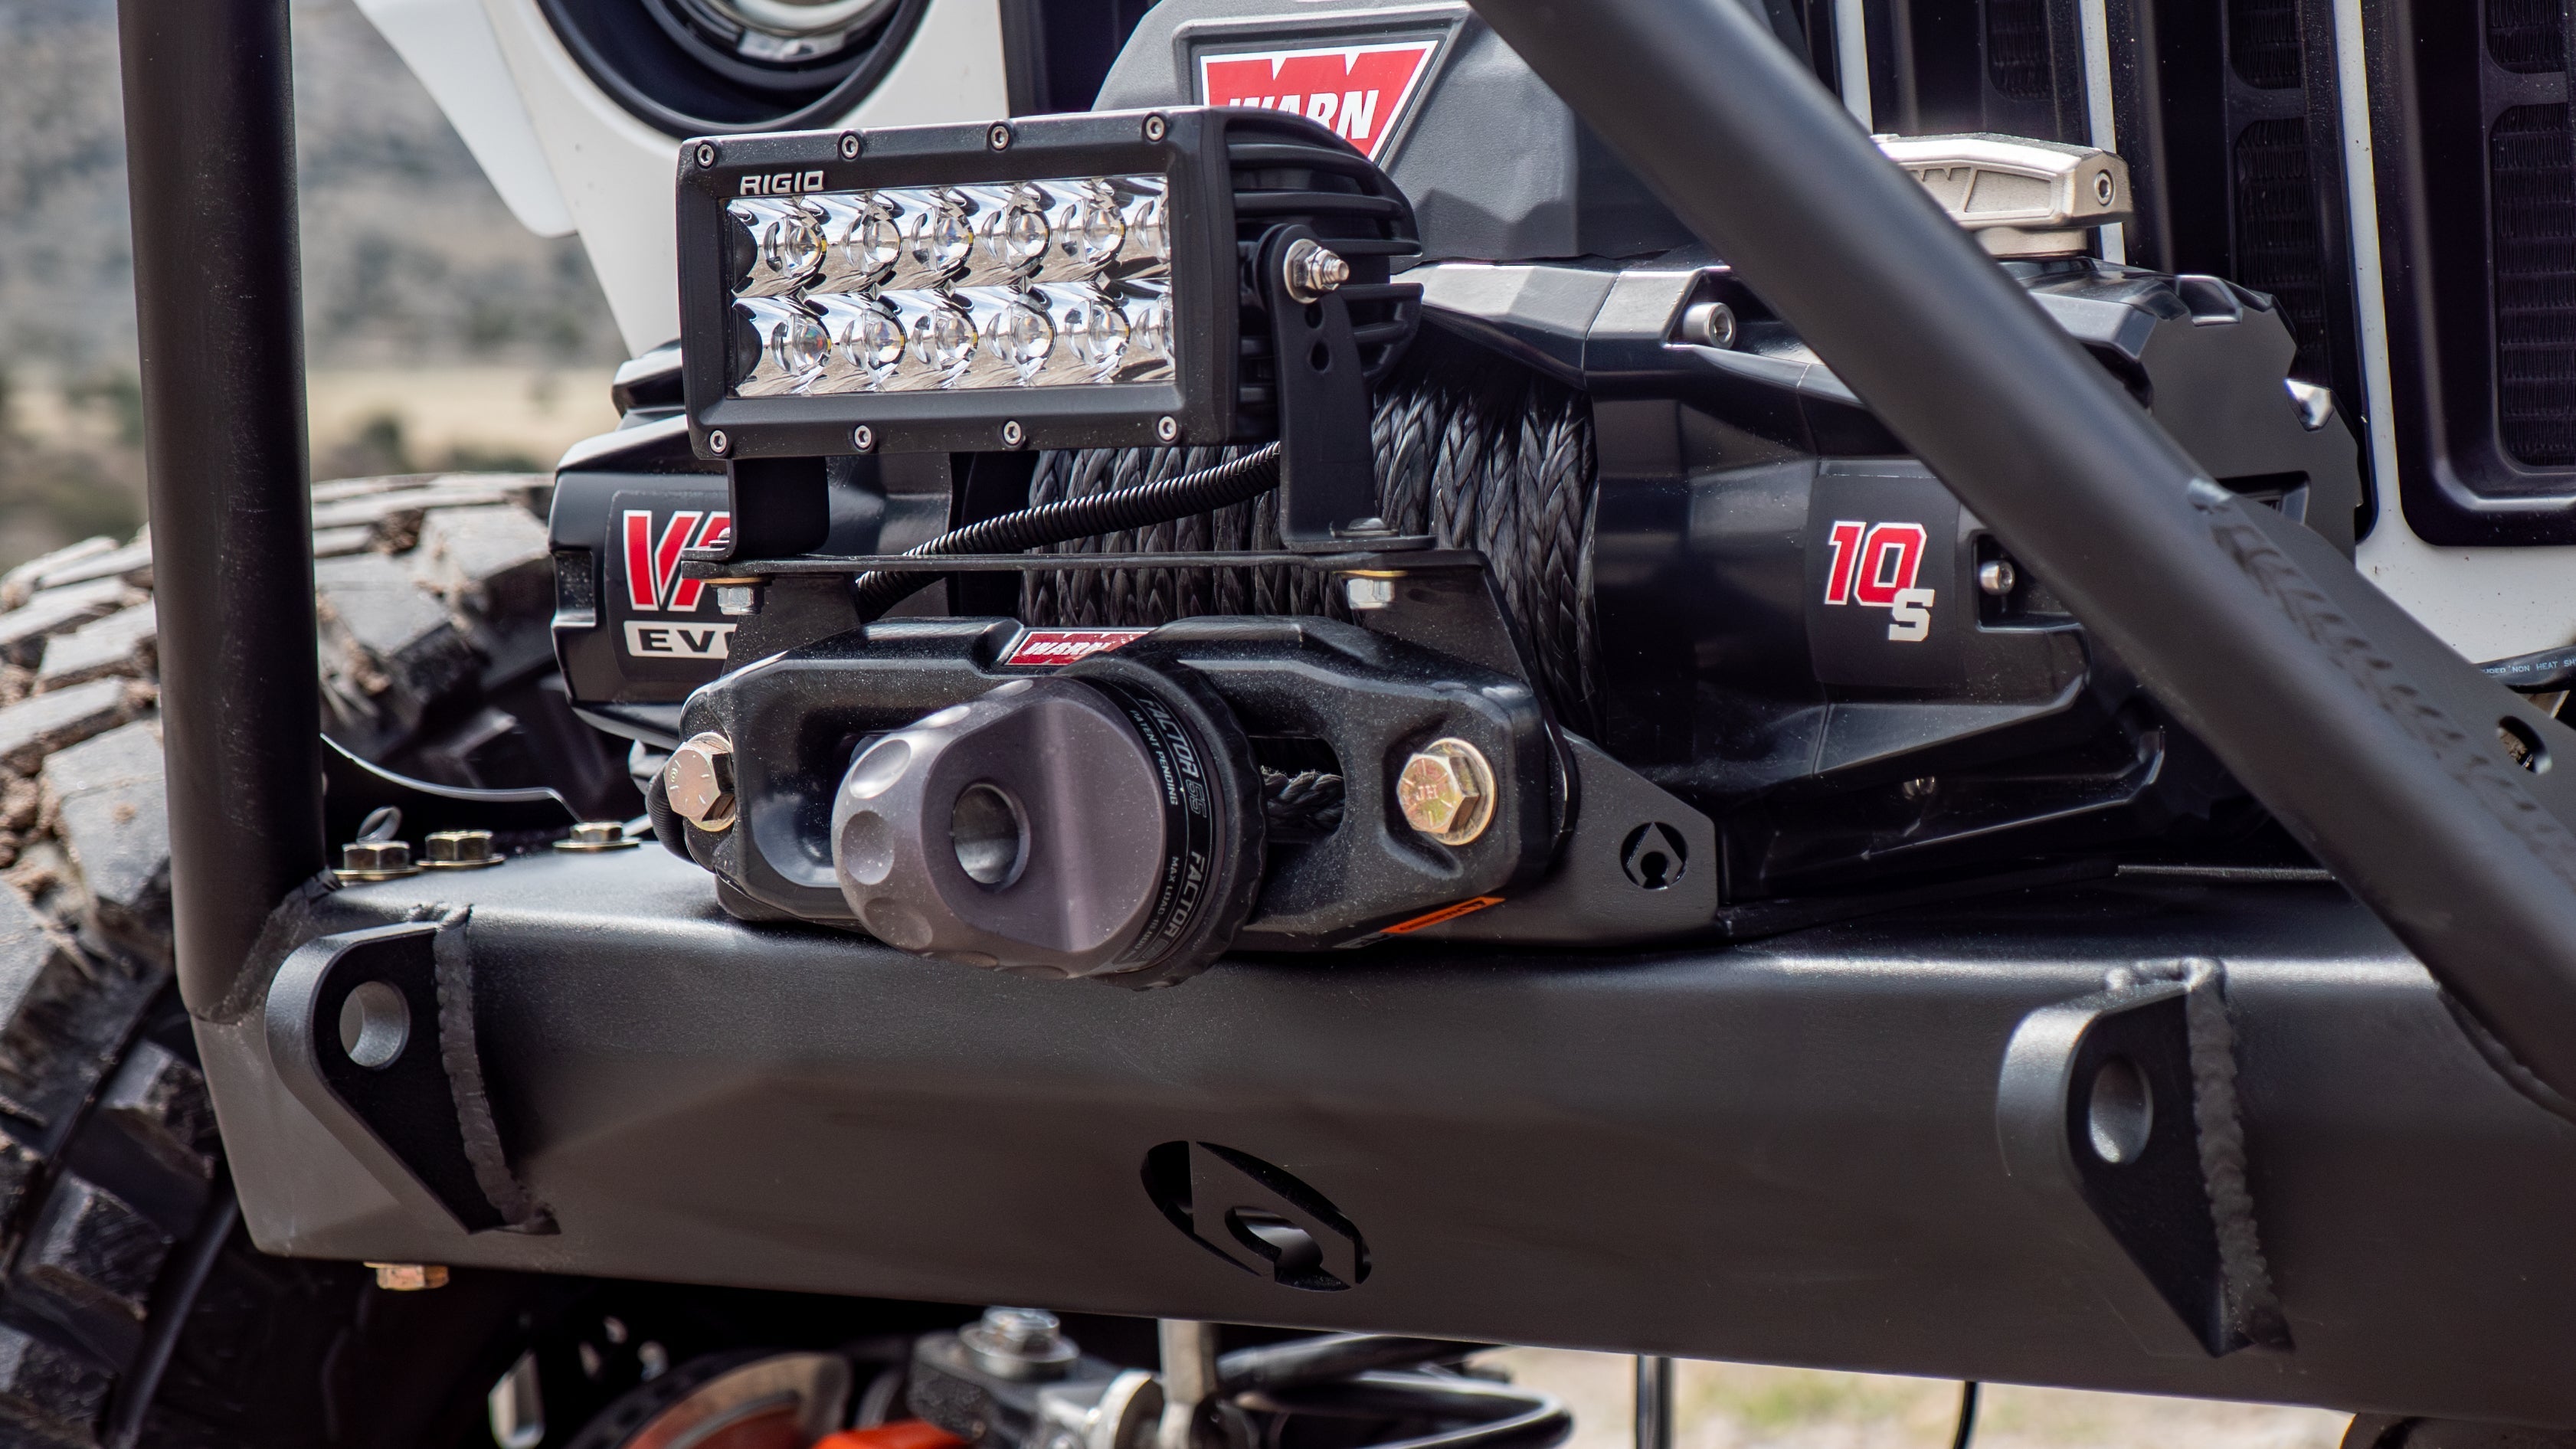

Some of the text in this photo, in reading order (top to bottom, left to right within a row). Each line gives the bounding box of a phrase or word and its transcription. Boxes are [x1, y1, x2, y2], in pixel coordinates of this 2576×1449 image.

[1229, 90, 1380, 139] RN
[740, 170, 824, 195] RIGID
[2536, 661, 2558, 671] HEAT
[1138, 698, 1200, 778] FACTOR
[1130, 710, 1178, 806] PATENT PENDING
[1168, 855, 1179, 882] MAX
[1157, 885, 1173, 915] LOAD
[1164, 851, 1205, 938] FACTOR
